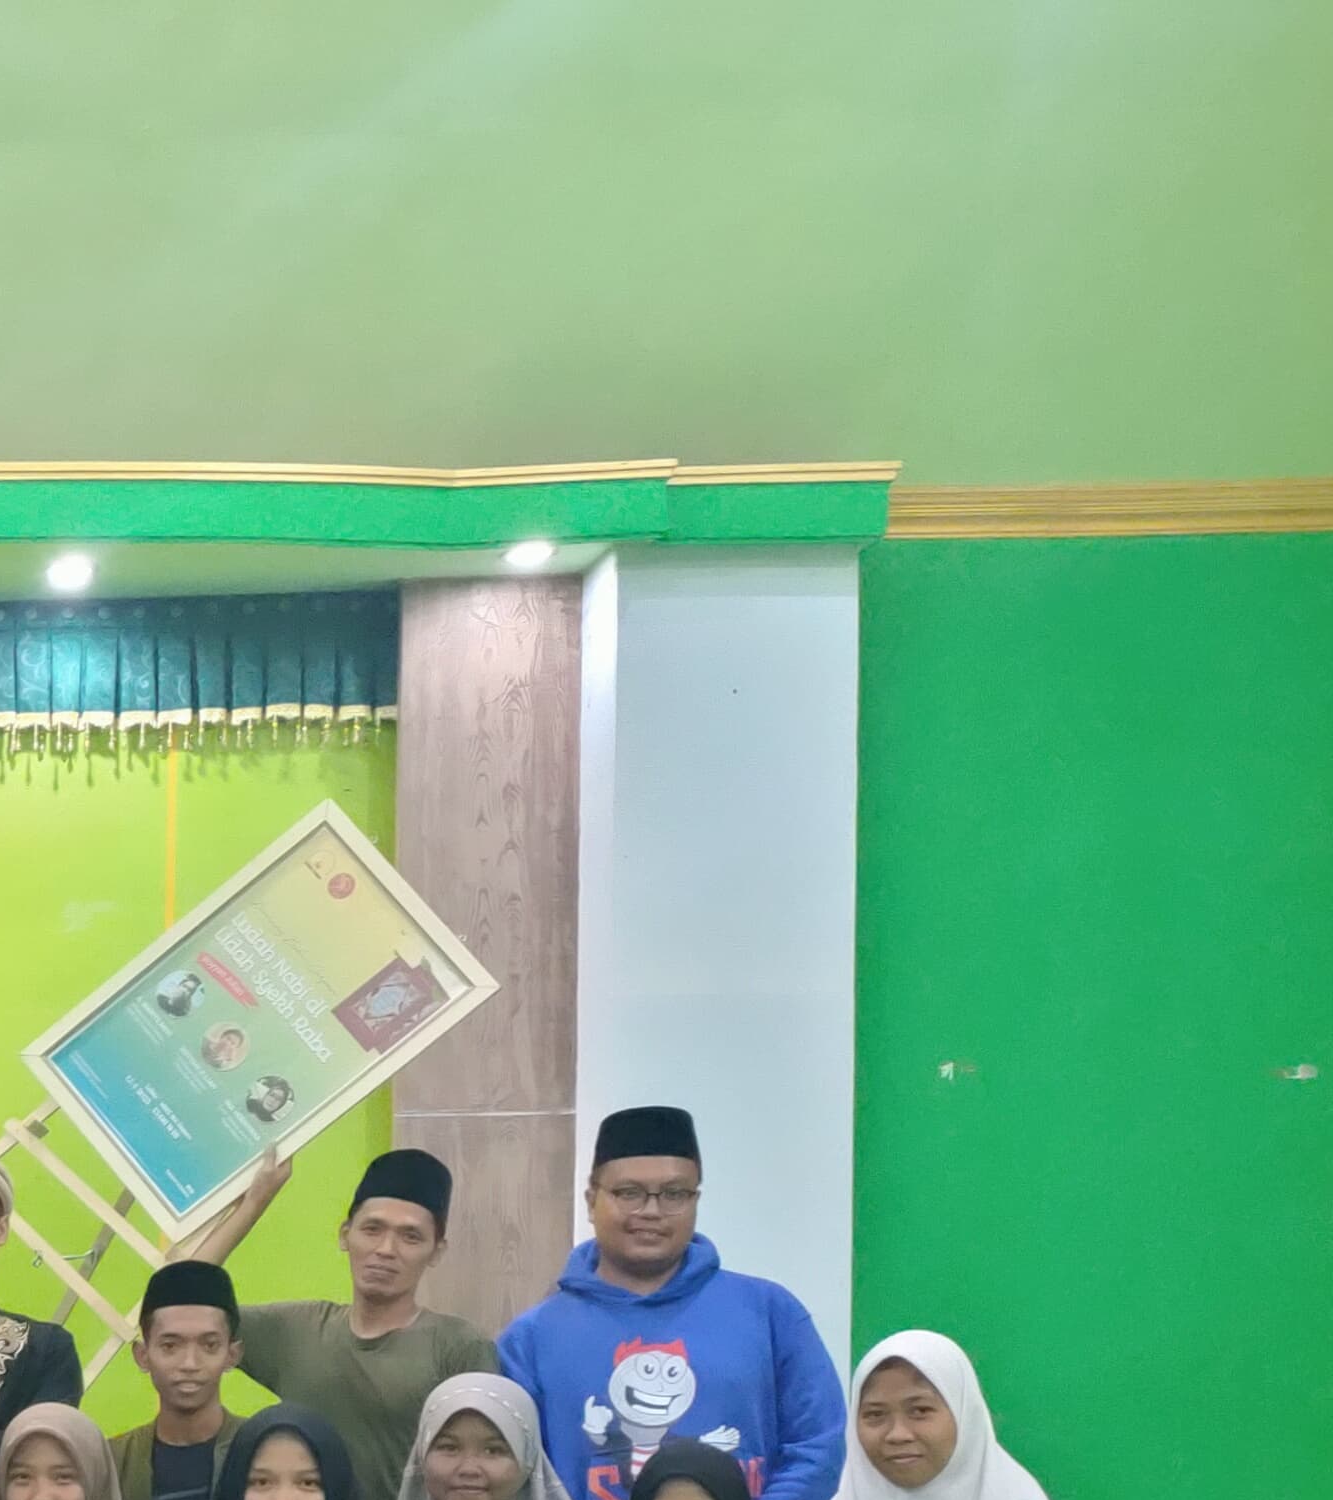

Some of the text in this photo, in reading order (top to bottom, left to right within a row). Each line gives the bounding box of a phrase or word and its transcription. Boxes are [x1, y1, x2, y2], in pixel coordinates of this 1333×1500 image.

[212, 924, 258, 973] Lidah
[247, 968, 299, 1022] Syekh
[289, 1012, 338, 1063] Raba
[230, 910, 279, 962] Ludah
[271, 956, 313, 1000] Nabi
